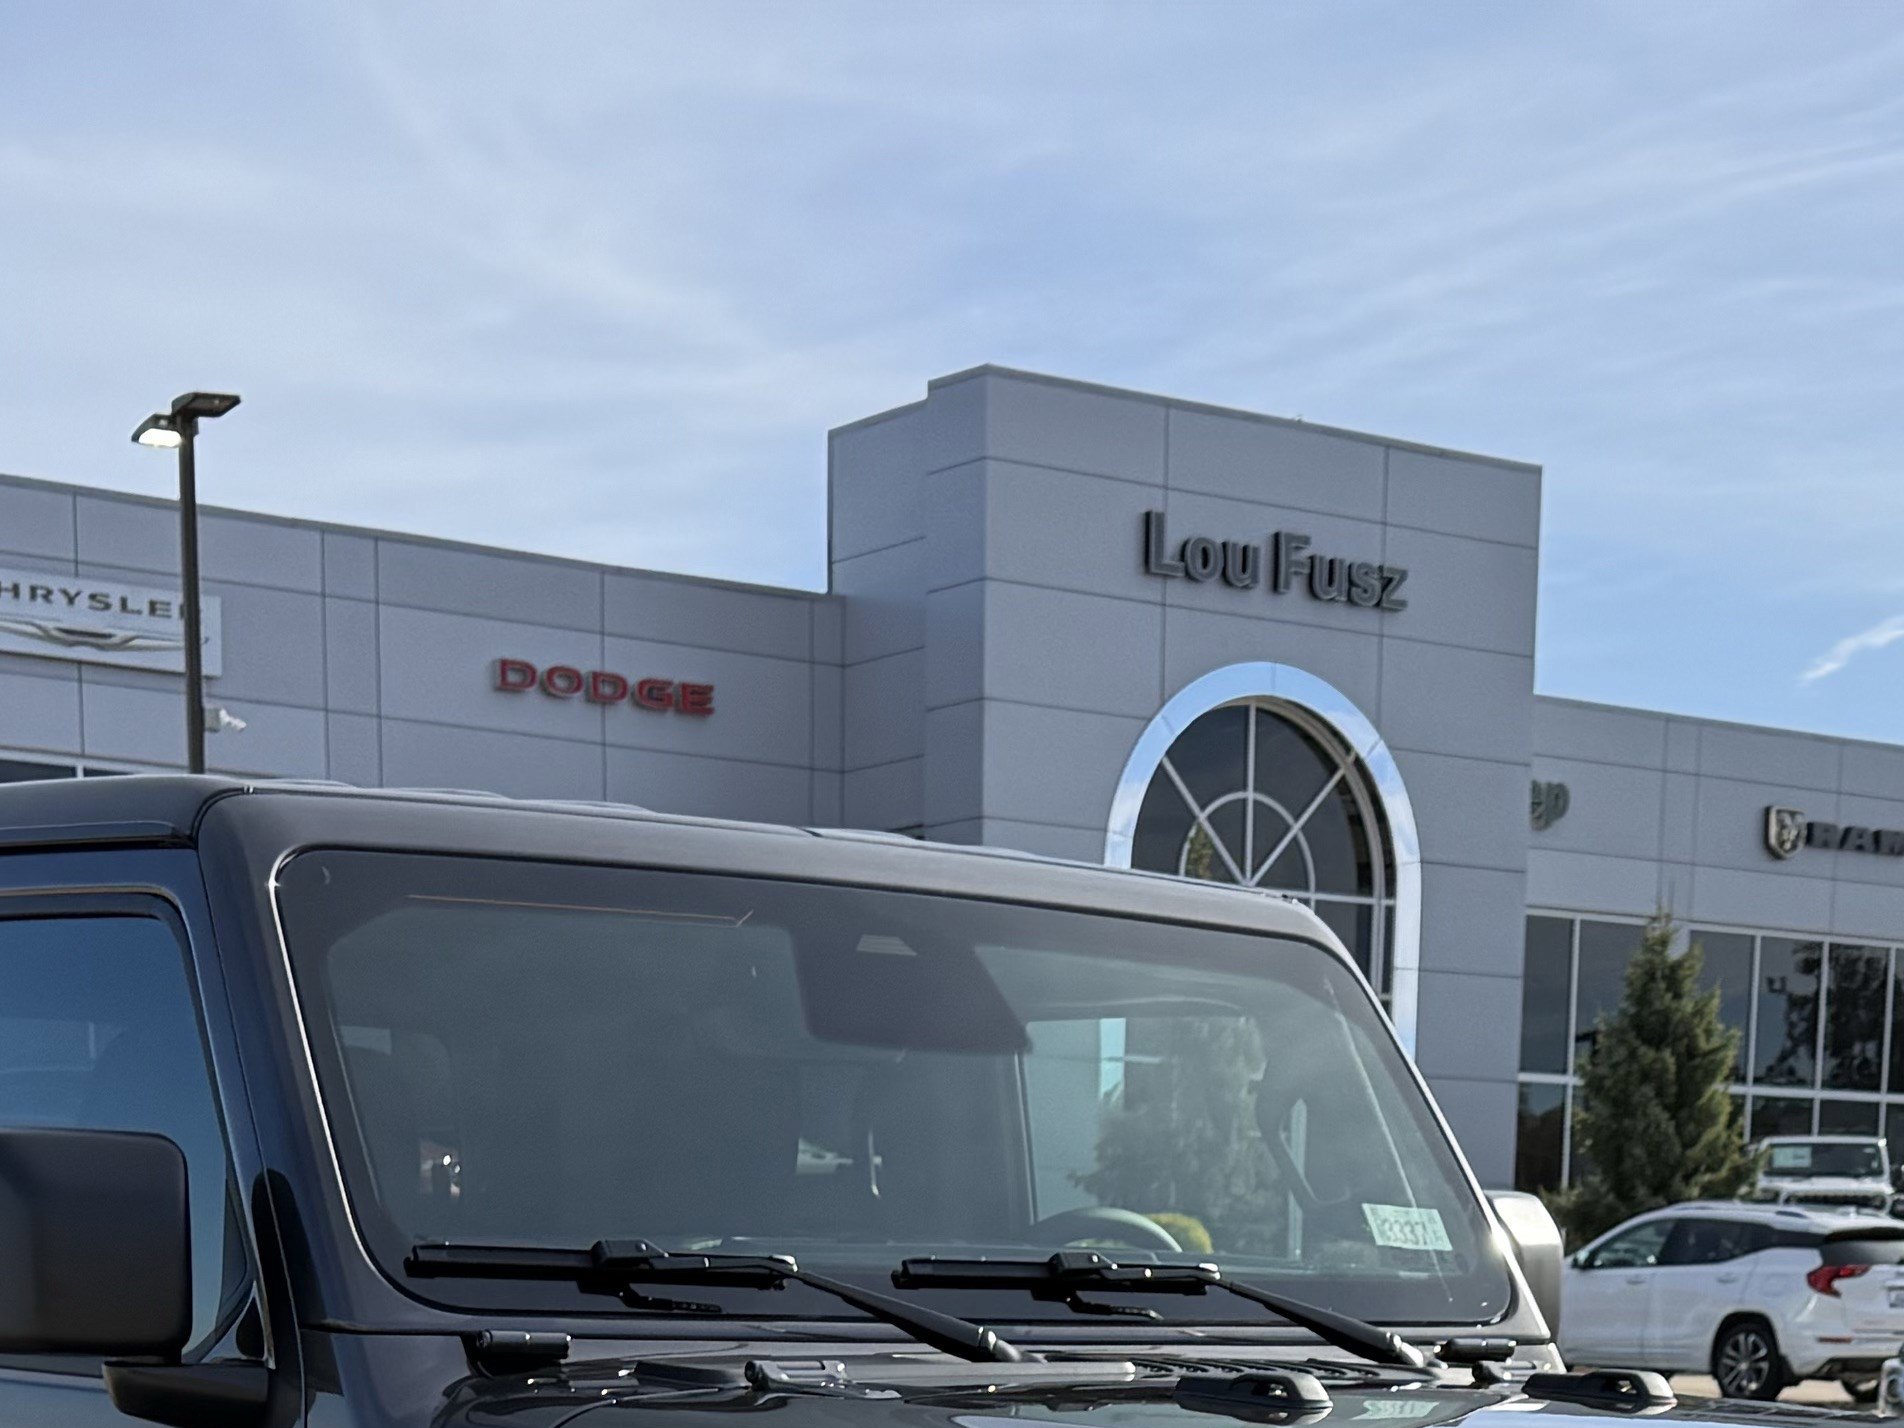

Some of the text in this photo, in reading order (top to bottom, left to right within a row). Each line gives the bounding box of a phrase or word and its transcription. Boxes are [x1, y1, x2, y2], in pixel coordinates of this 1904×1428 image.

[1142, 509, 1409, 612] Lou Fusz
[494, 657, 716, 717] DODGE
